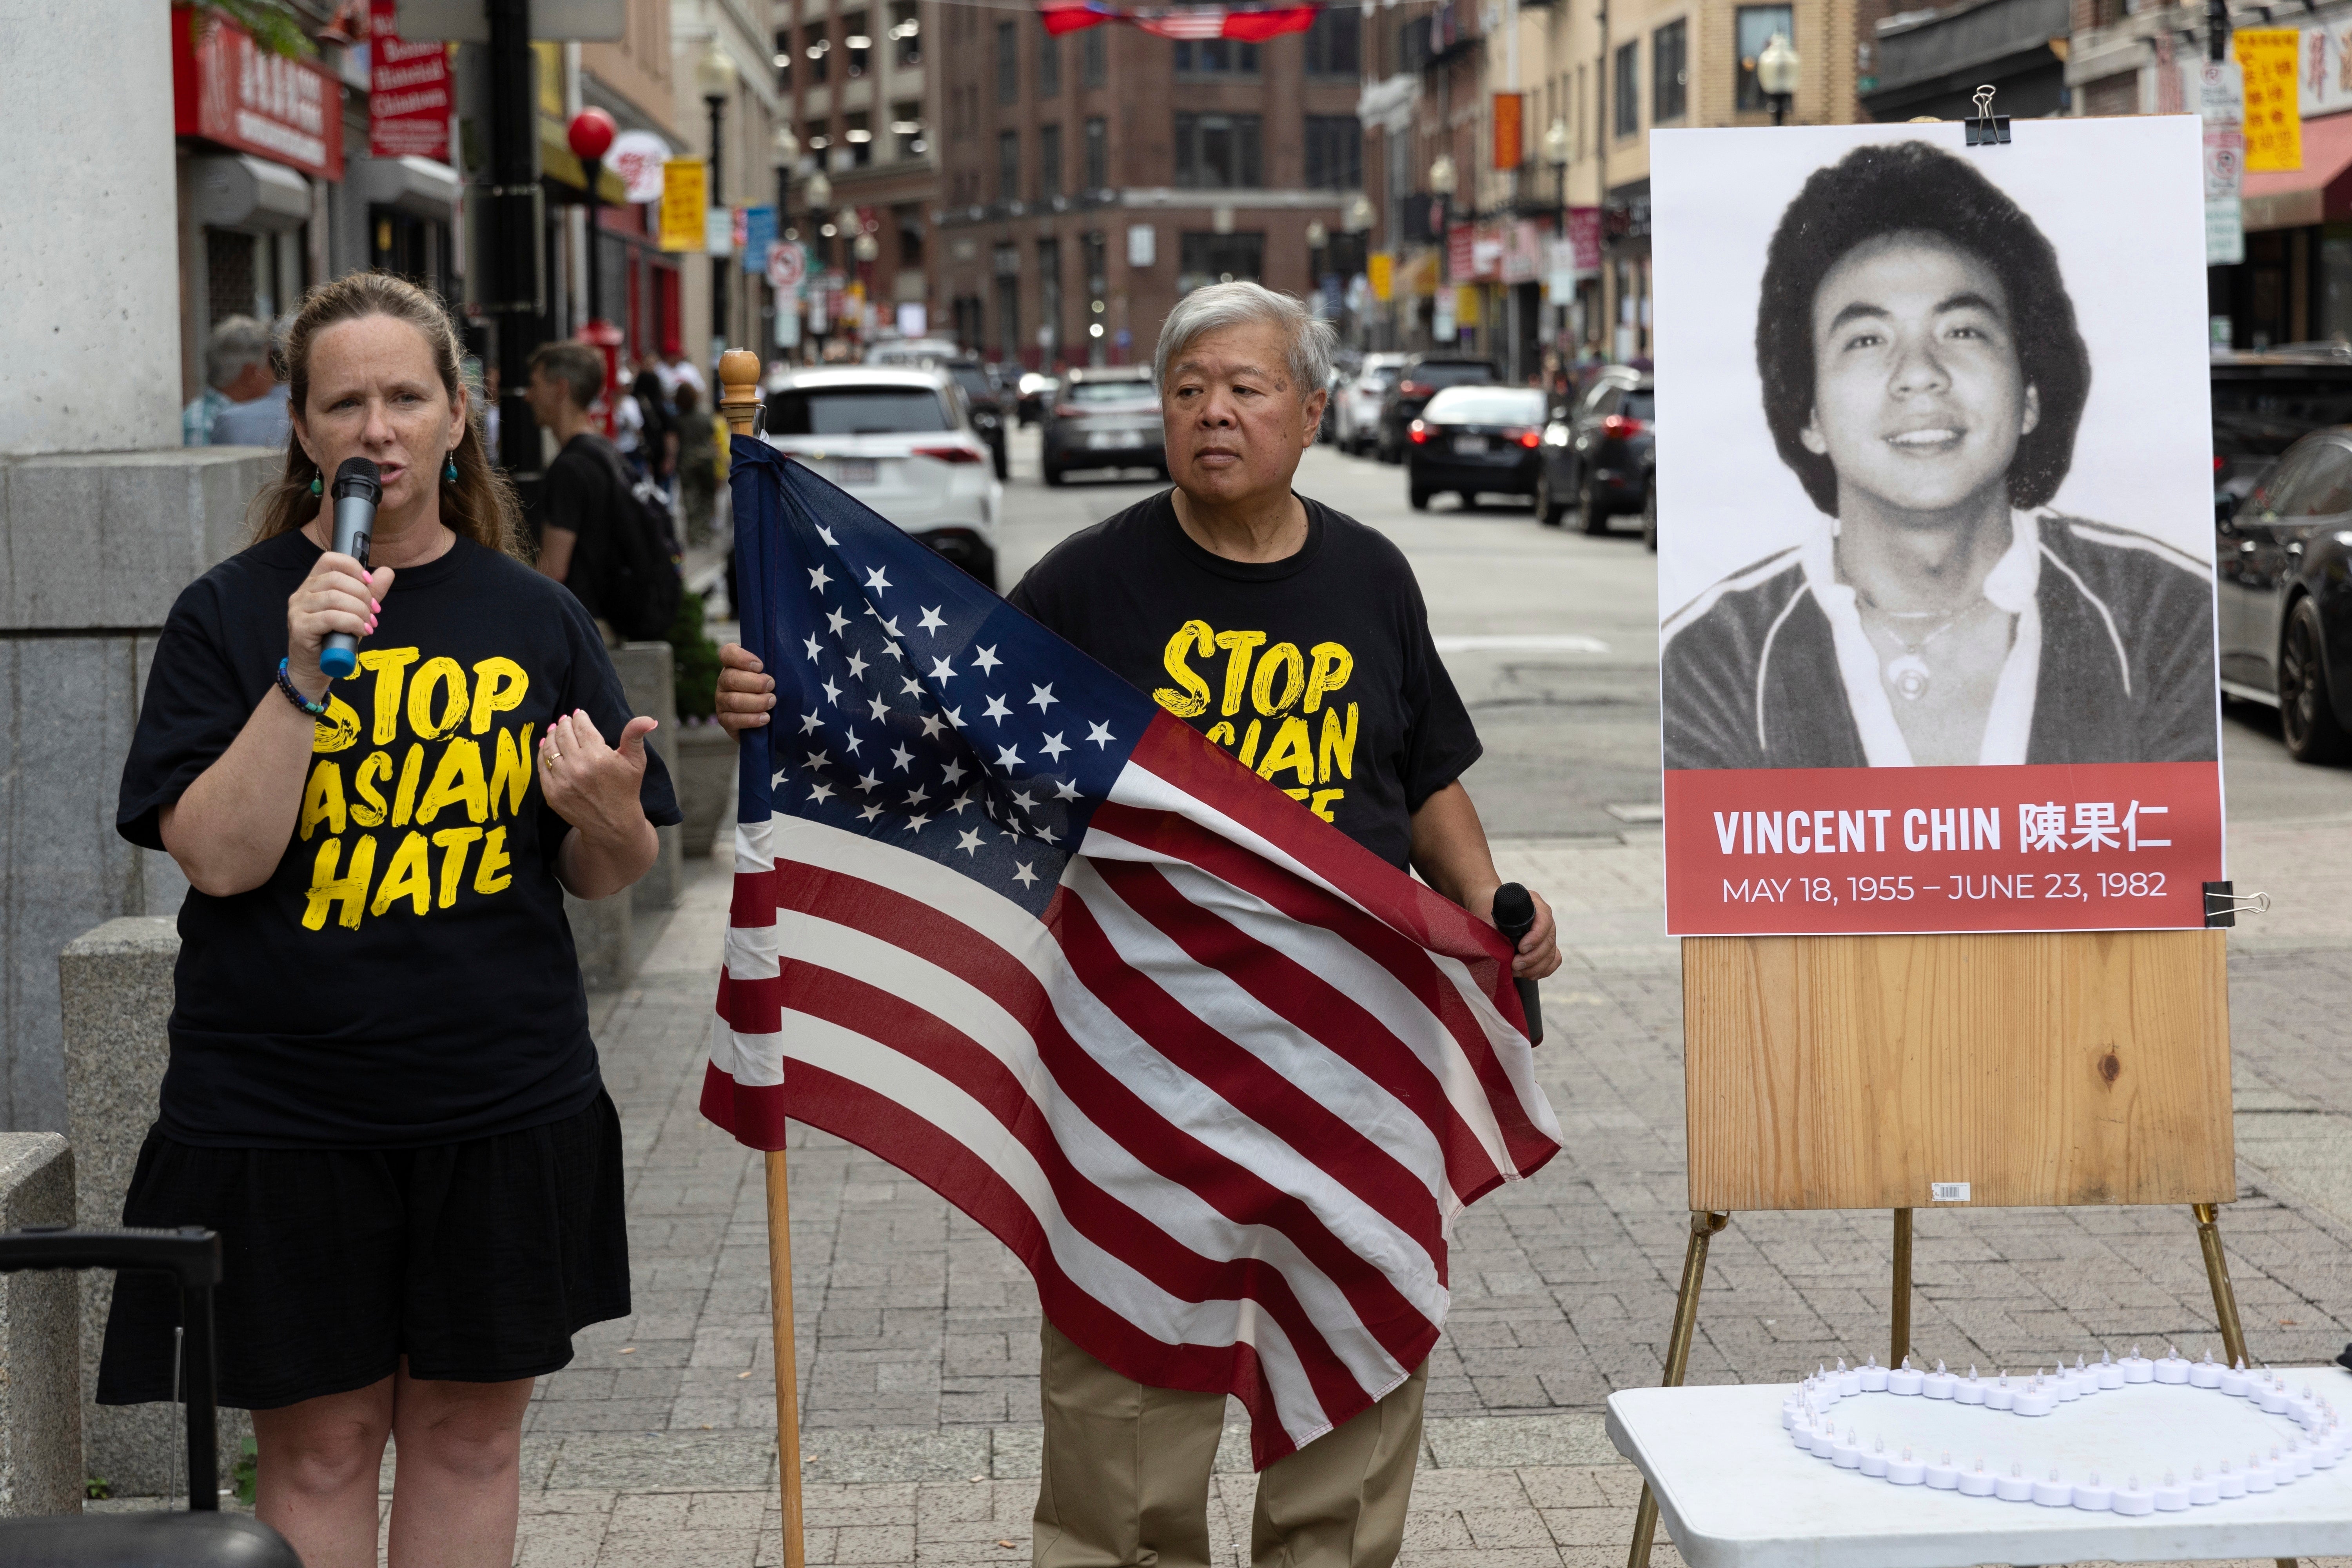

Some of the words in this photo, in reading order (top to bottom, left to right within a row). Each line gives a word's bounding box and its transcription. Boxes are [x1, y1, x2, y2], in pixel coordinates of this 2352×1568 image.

[1152, 619, 1354, 719] STOP
[300, 722, 535, 842] ASIAN
[1204, 702, 1359, 786] IAN
[1713, 809, 1891, 854] VINCENT
[1903, 808, 2001, 852] CHIN
[2018, 800, 2172, 853] 陳果仁
[301, 825, 513, 931] HATE
[1723, 878, 1792, 903] MAY
[1799, 878, 1838, 907] 18,
[1847, 876, 1915, 902] 1955
[1948, 874, 2035, 900] JUNE
[2044, 873, 2089, 903] 23,
[2096, 872, 2168, 898] 1982
